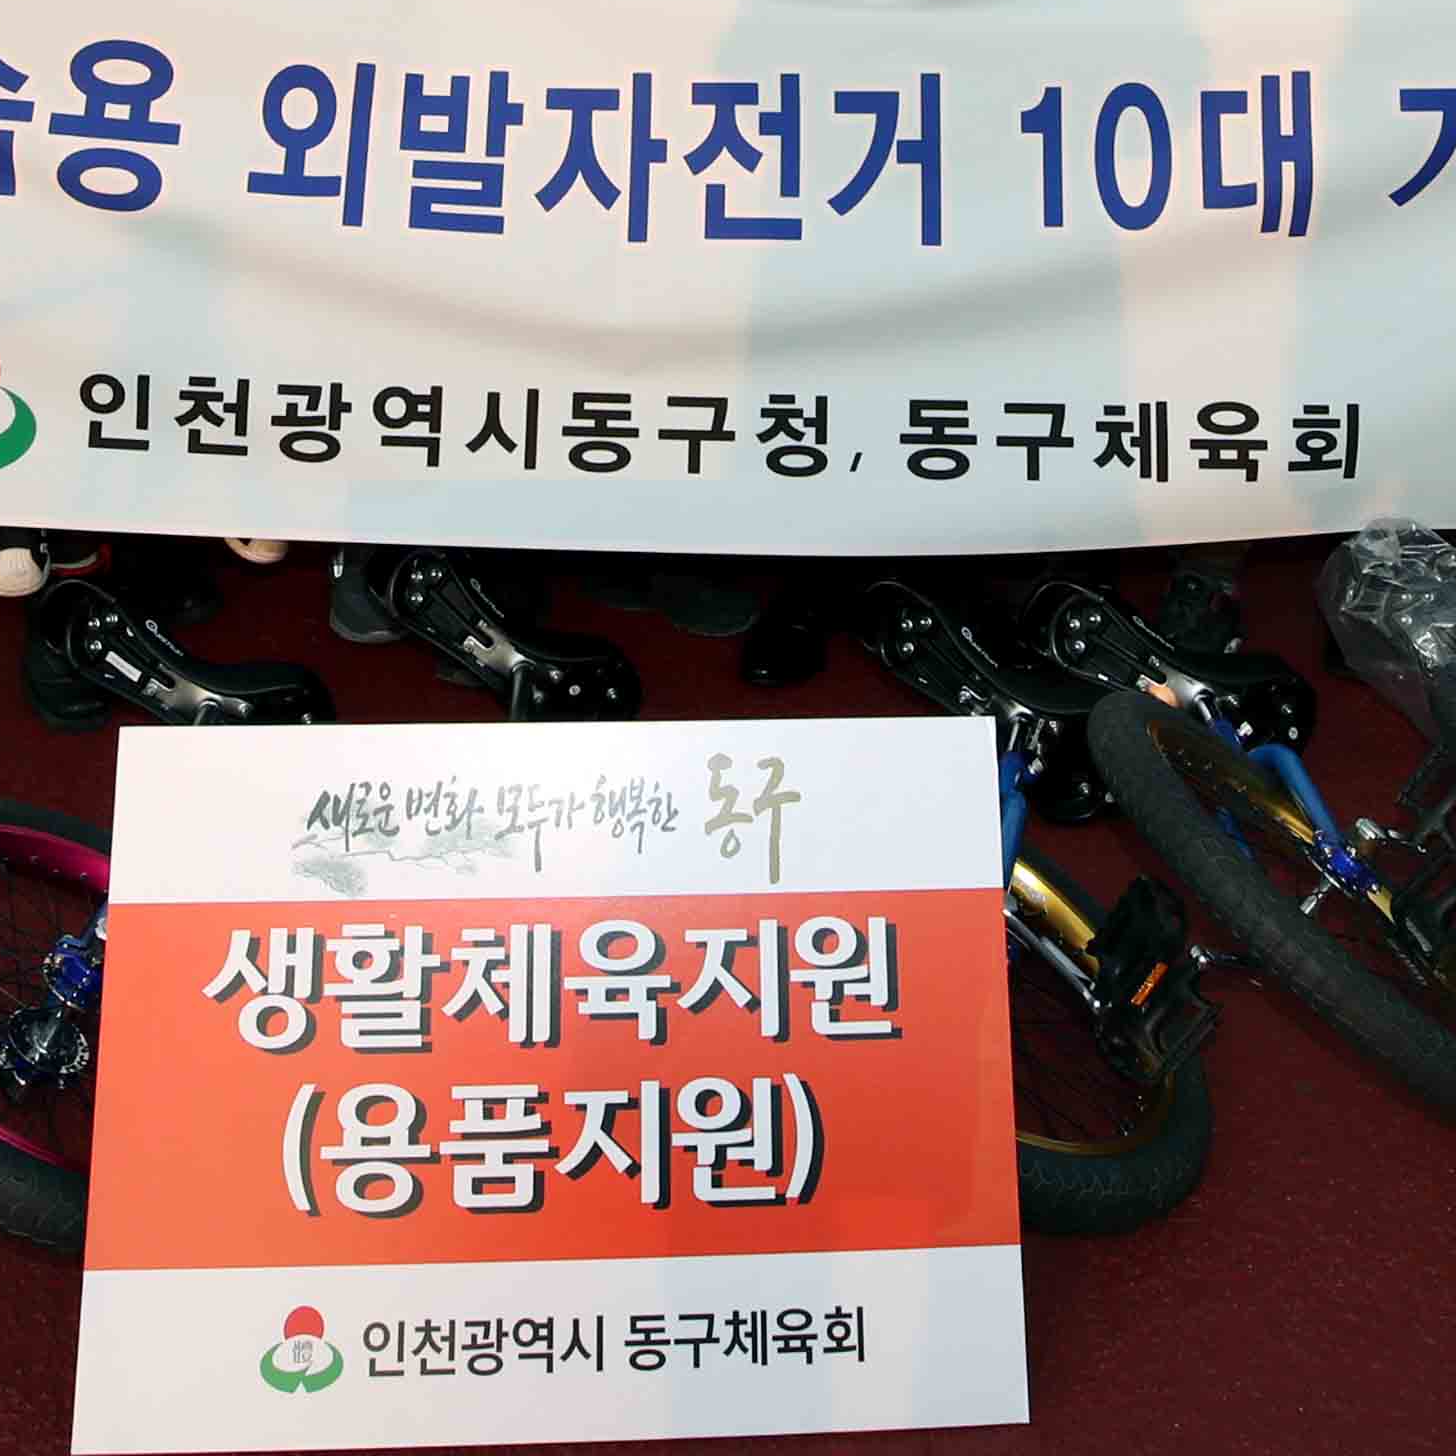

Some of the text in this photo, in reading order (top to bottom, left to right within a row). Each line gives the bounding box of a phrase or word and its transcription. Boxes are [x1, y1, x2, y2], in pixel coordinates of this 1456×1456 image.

[246, 61, 943, 247] 외발자전거
[1018, 70, 1314, 237] 10대
[78, 372, 1360, 483] 인천광역시동구청, 동구체육회
[306, 752, 801, 886] 새로운 변화 모두가 행복한 동구
[202, 915, 901, 1052] 생활체육지원
[281, 1072, 823, 1214] (용품지원)
[361, 1305, 866, 1377] 인천광역시 동구체육회
